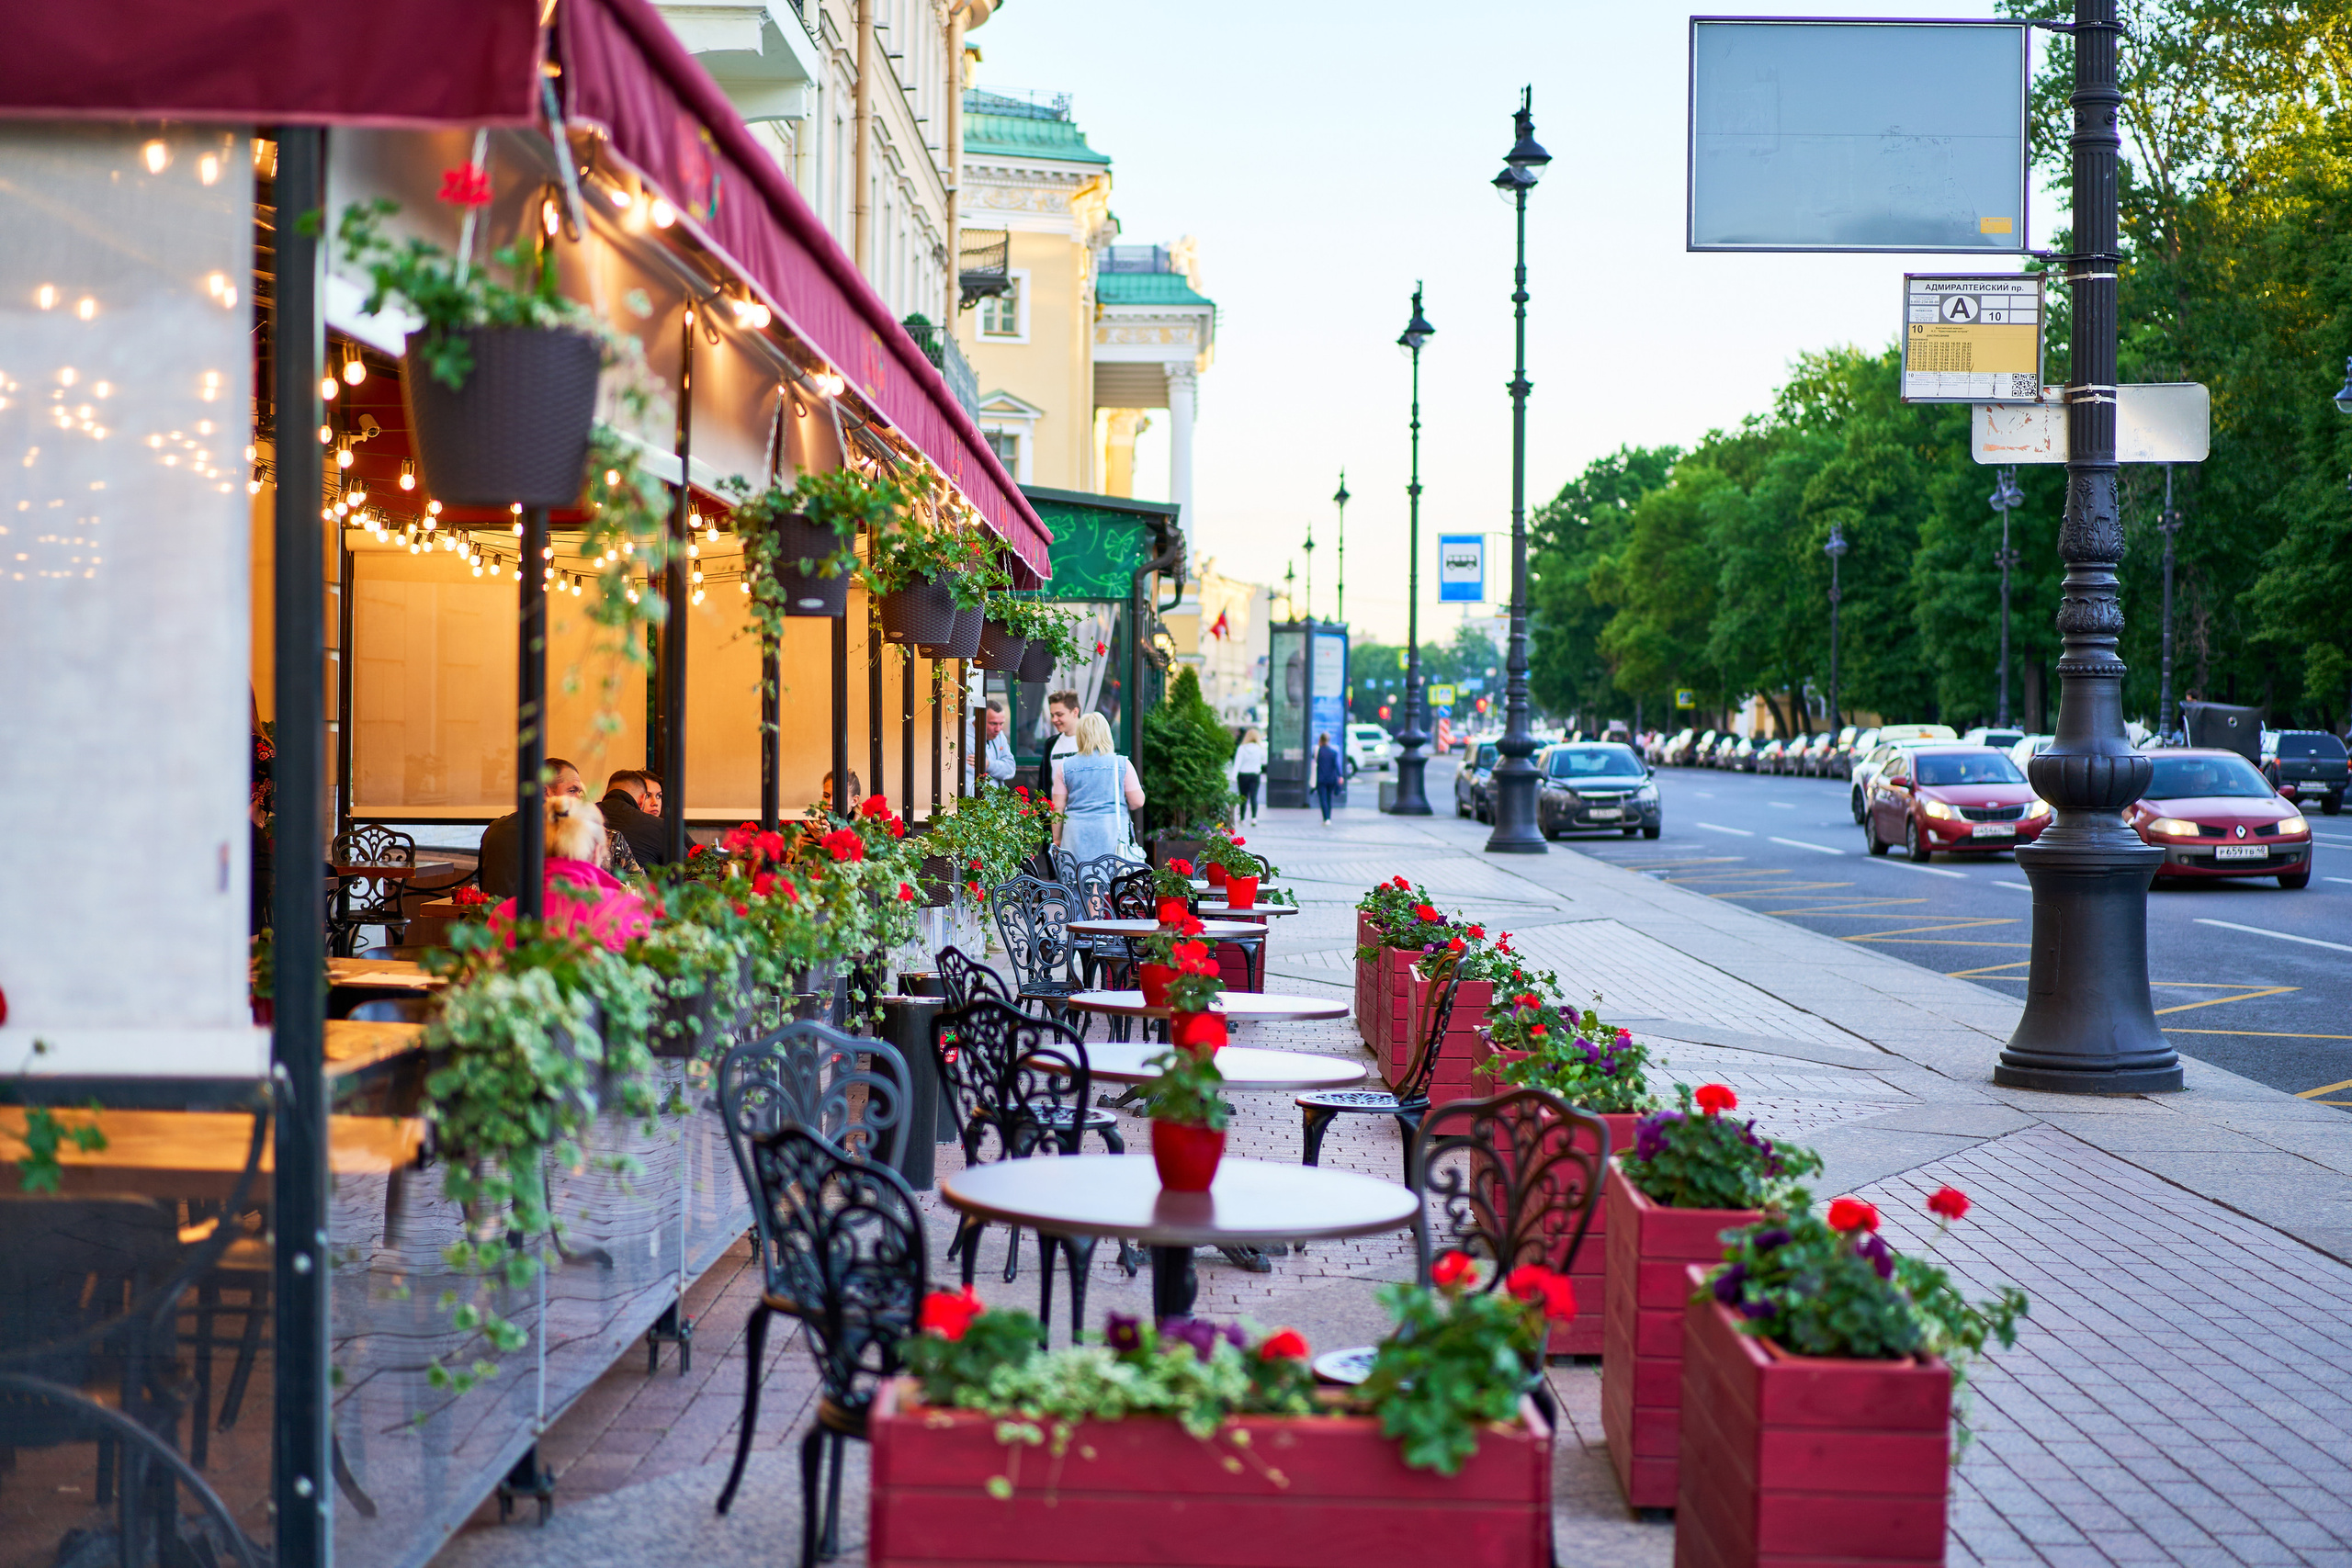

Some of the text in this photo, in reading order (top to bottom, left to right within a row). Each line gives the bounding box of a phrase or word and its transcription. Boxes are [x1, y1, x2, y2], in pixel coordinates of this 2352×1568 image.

[1925, 283, 2009, 291] АДМИРАЛТЕЙСКИЙ
[1950, 298, 1971, 319] А
[1989, 312, 2002, 321] 10
[1912, 324, 1923, 333] 10
